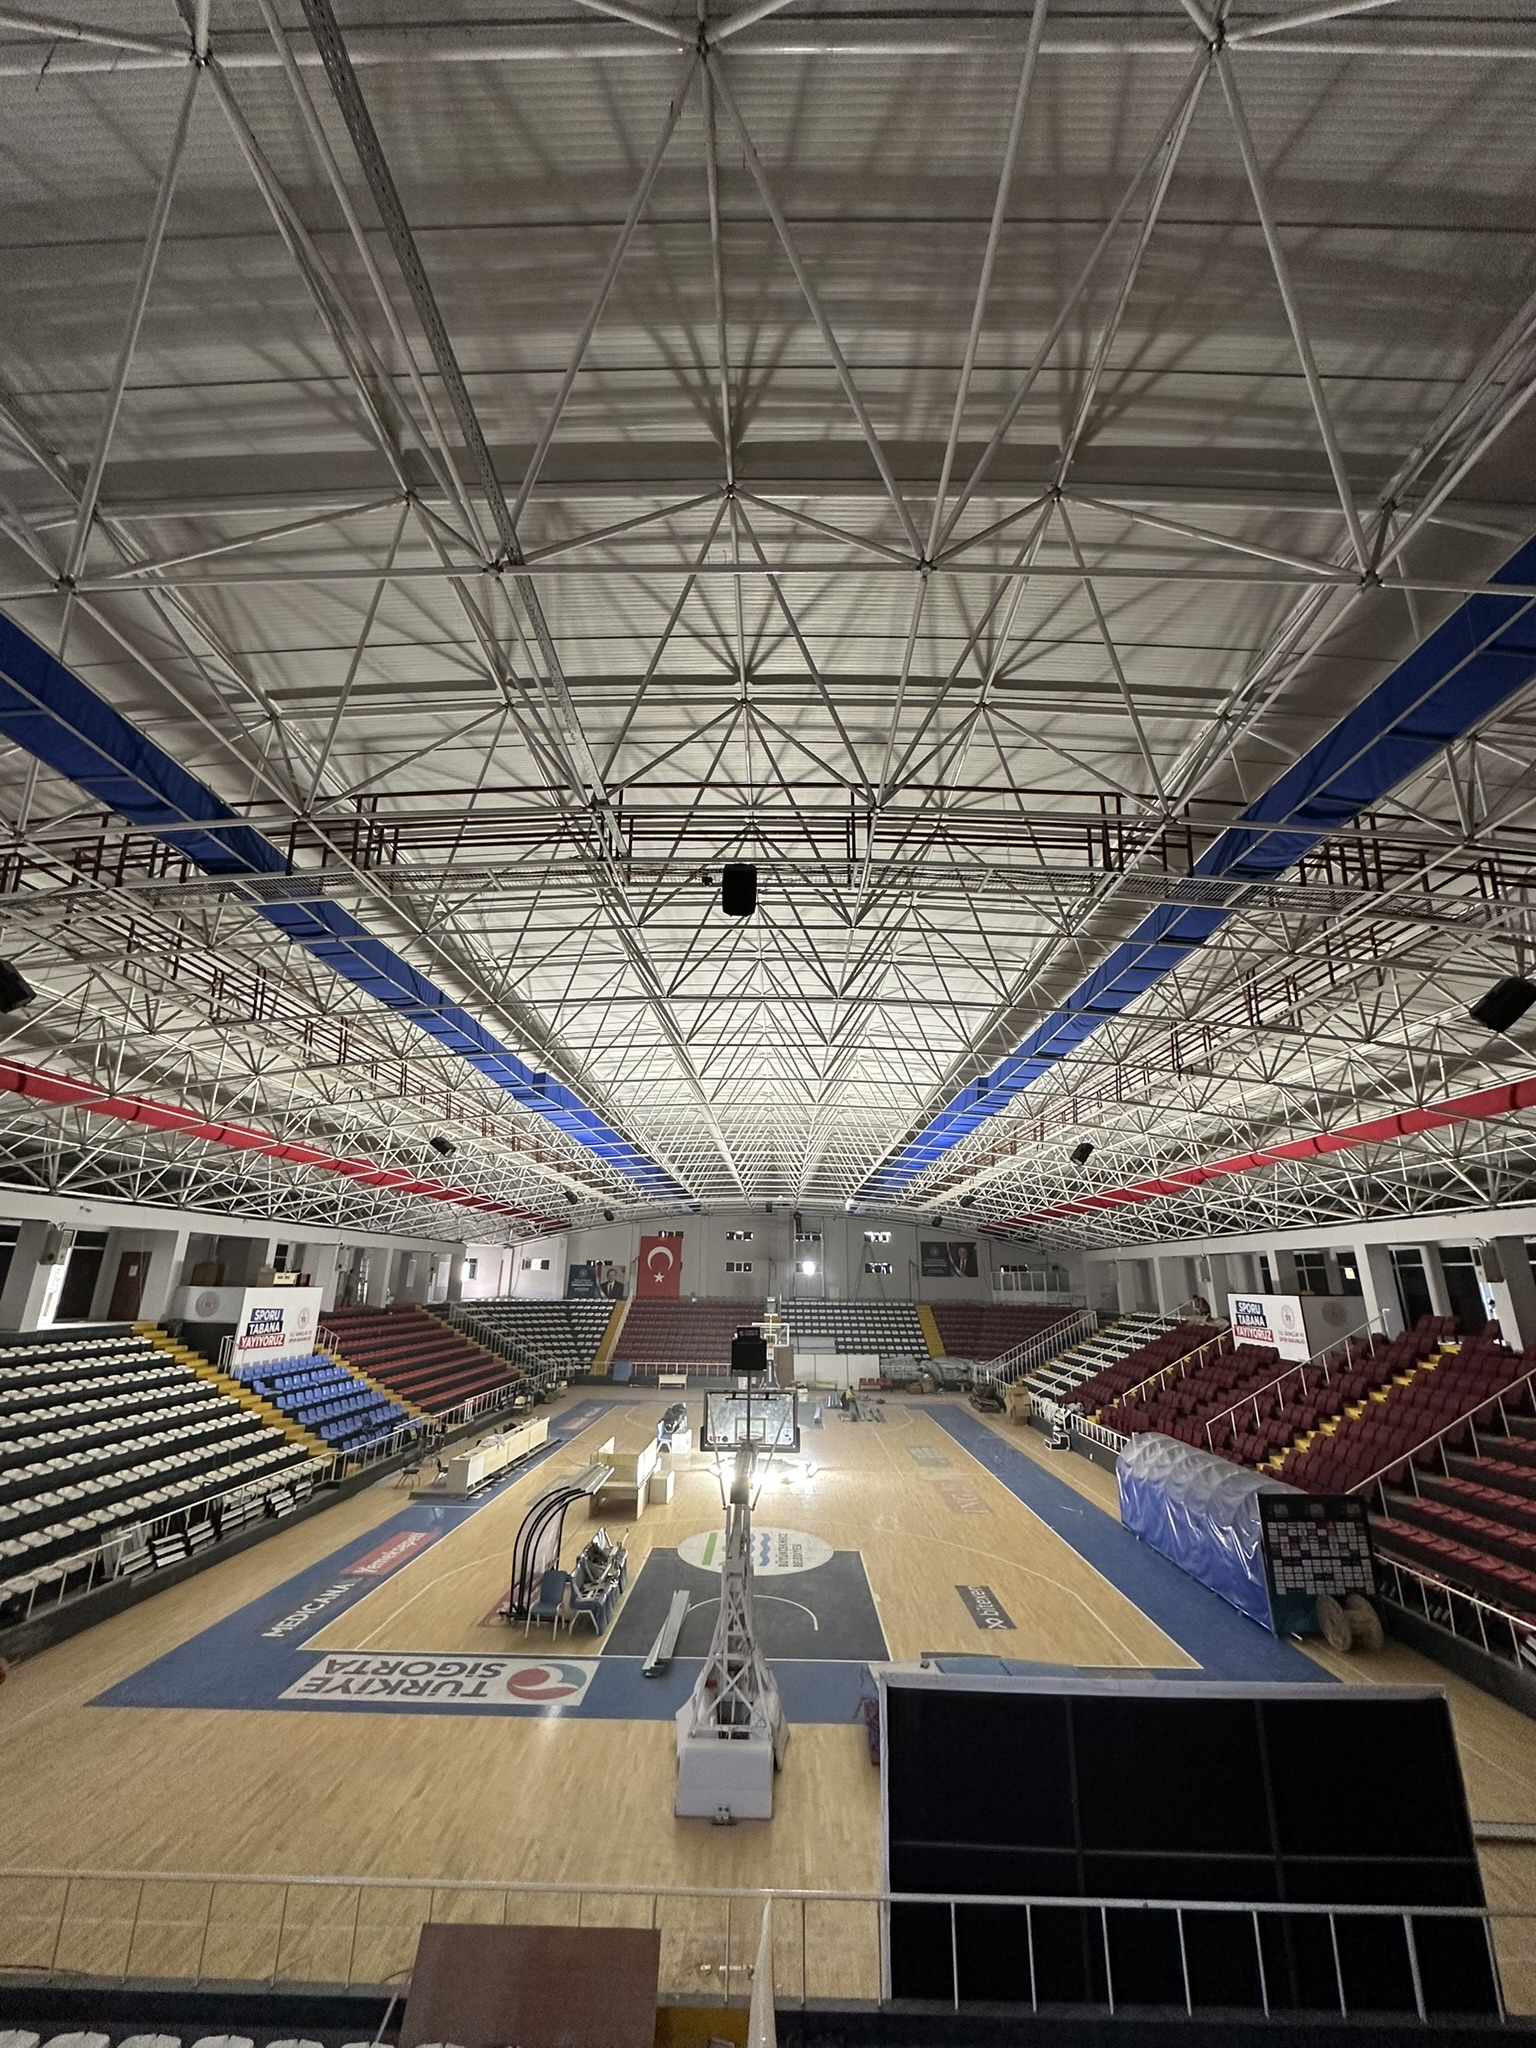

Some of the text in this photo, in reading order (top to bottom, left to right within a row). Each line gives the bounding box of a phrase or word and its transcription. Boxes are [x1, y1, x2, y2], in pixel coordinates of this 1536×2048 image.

[254, 1309, 281, 1321] SPORU
[1238, 1302, 1260, 1314] SPORU
[1237, 1314, 1266, 1327] TABANA
[249, 1321, 280, 1335] TABANA
[1236, 1326, 1273, 1341] YAYIYORUZ
[240, 1334, 284, 1348] YAYIYORUZ
[261, 1582, 356, 1638] MEDICANA
[325, 1659, 508, 1679] SİGORTA
[297, 1677, 488, 1698] TÜRKİYE
